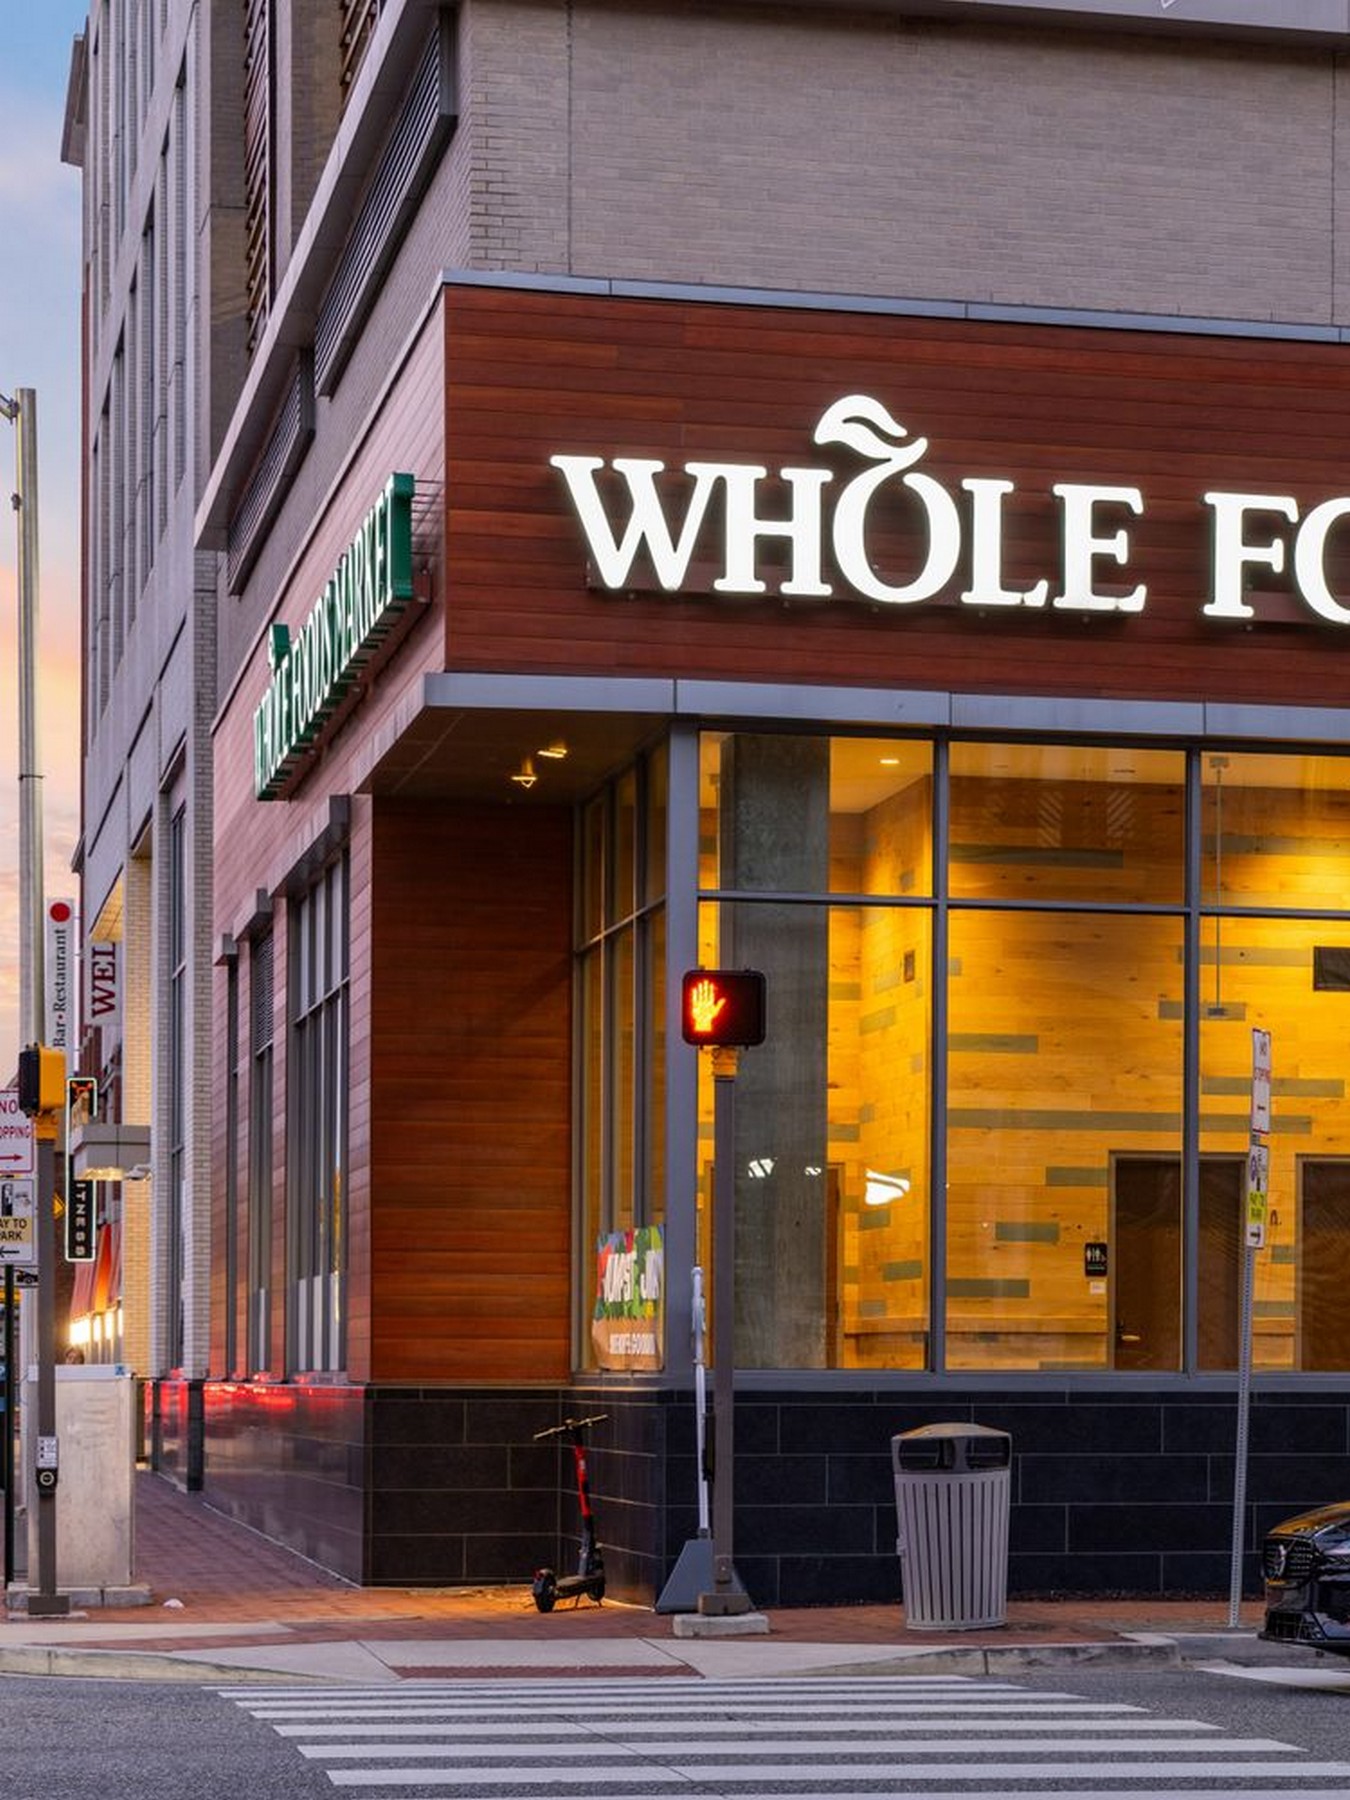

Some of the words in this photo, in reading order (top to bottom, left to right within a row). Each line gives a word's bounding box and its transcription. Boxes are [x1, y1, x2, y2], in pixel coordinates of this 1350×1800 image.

[550, 394, 1147, 612] WHOLE
[13, 1219, 27, 1229] TO
[0, 1231, 22, 1240] ARK
